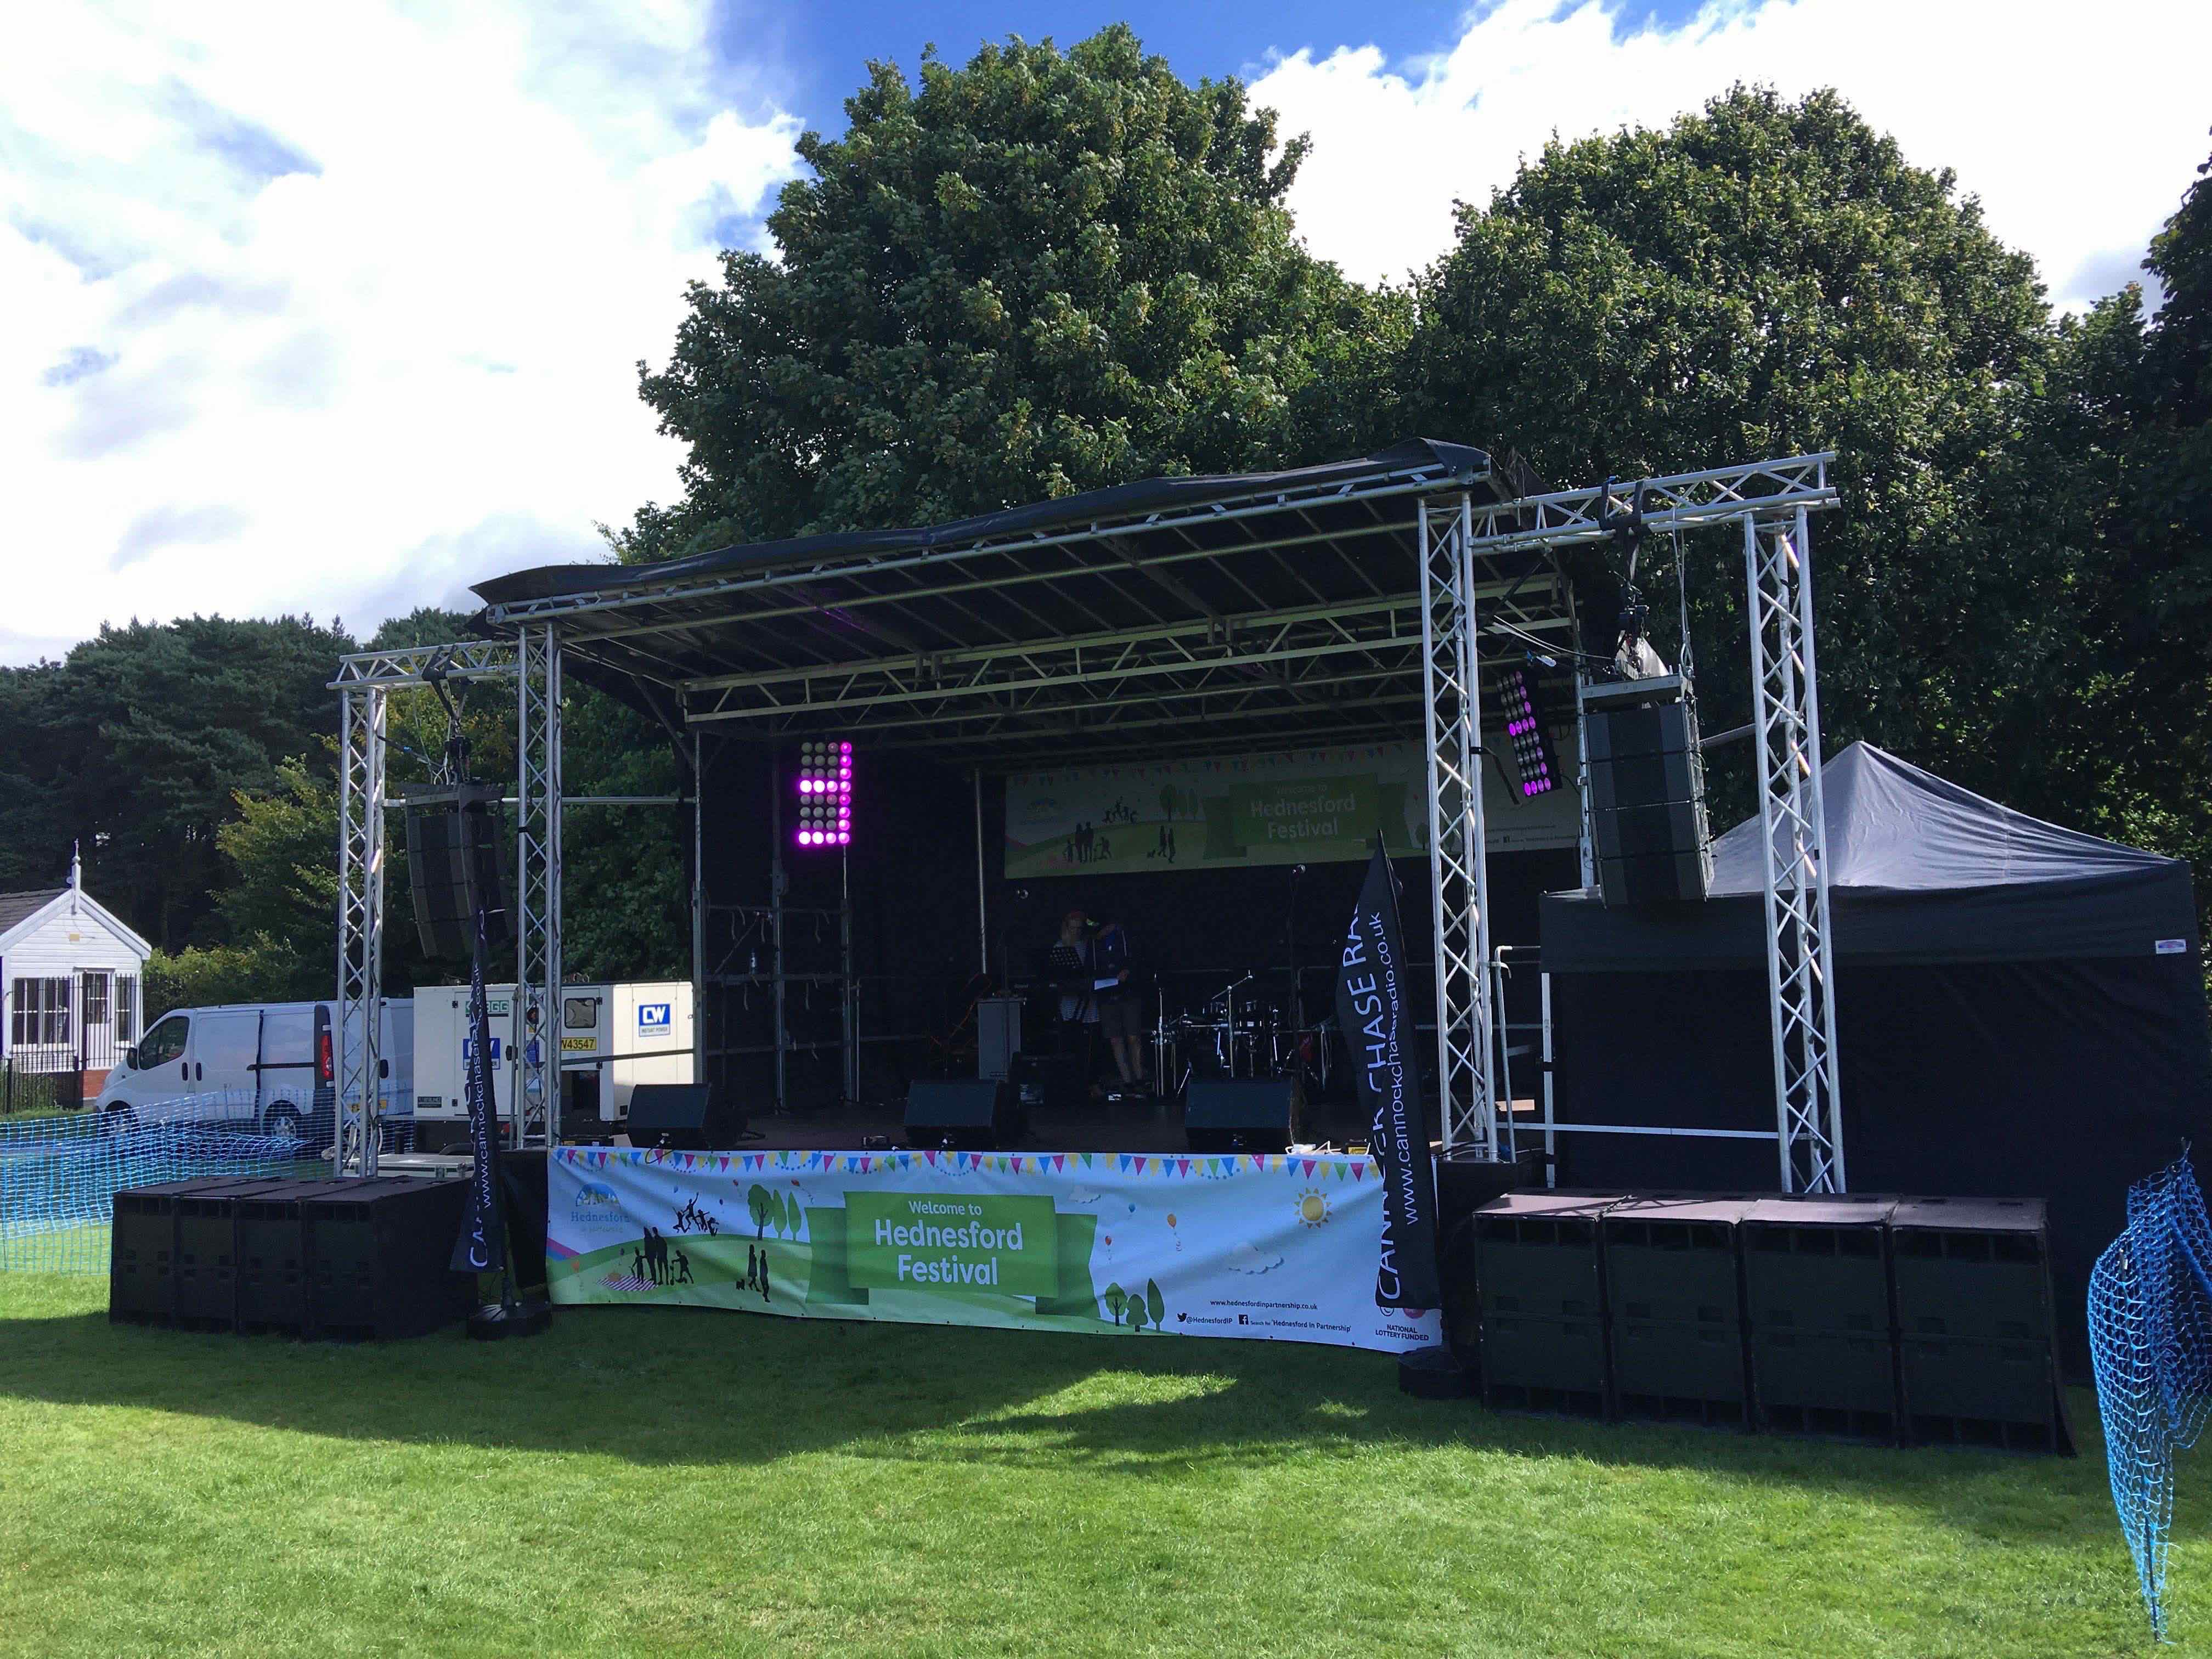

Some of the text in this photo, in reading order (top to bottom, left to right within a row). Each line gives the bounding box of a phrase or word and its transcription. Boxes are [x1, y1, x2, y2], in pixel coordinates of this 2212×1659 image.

[1250, 792, 1356, 818] Hednesford
[1267, 816, 1339, 839] Festival
[643, 1006, 666, 1023] CW
[1369, 911, 1419, 1225] www.cannockchaseradio.co.uk
[909, 1201, 983, 1215] Welcome to
[875, 1219, 1023, 1250] Hednesford
[898, 1255, 998, 1285] Festival
[1210, 1300, 1318, 1310] www.hednesfordinpartnership.co.uk
[1375, 1329, 1430, 1341] LOTTERY FUNDED
[1387, 1324, 1418, 1334] NATIONAL
